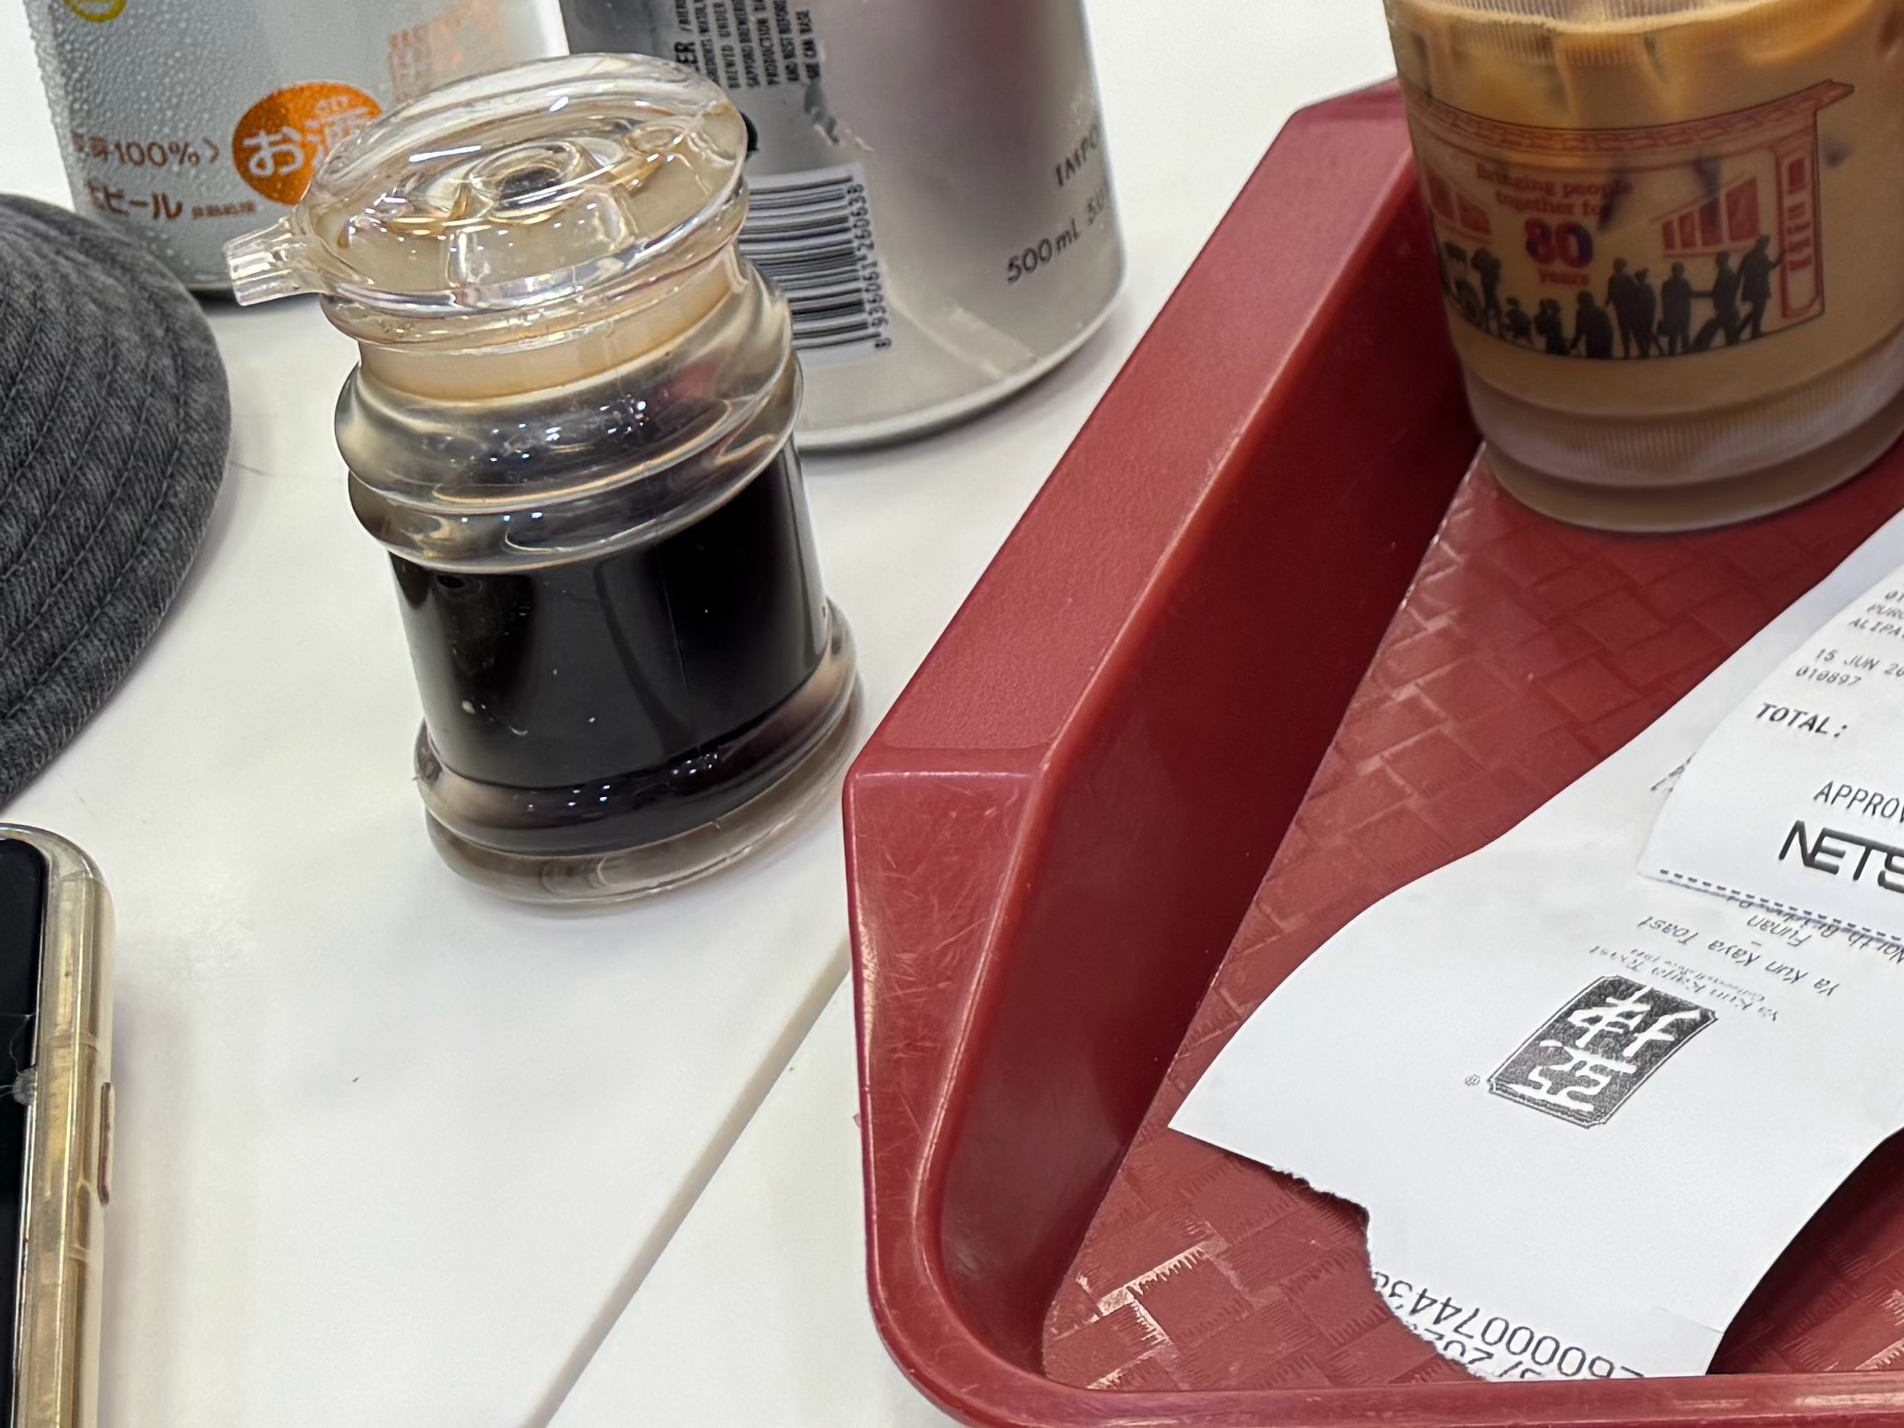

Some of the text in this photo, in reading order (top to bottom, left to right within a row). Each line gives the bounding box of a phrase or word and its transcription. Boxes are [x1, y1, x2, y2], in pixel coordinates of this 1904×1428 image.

[713, 2, 731, 38] UNDER
[721, 45, 740, 88] BREWED
[757, 18, 780, 85] PRODUCTION
[1523, 217, 1594, 269] 80
[1794, 665, 1864, 689] 010897
[1813, 646, 1839, 664] 15
[1842, 654, 1881, 673] JUN
[1754, 700, 1850, 740] TOTAL:
[1746, 913, 1813, 948] Funan
[1637, 915, 1841, 997] Ya Kun Kaya Toast
[1710, 987, 1753, 1012] Kun
